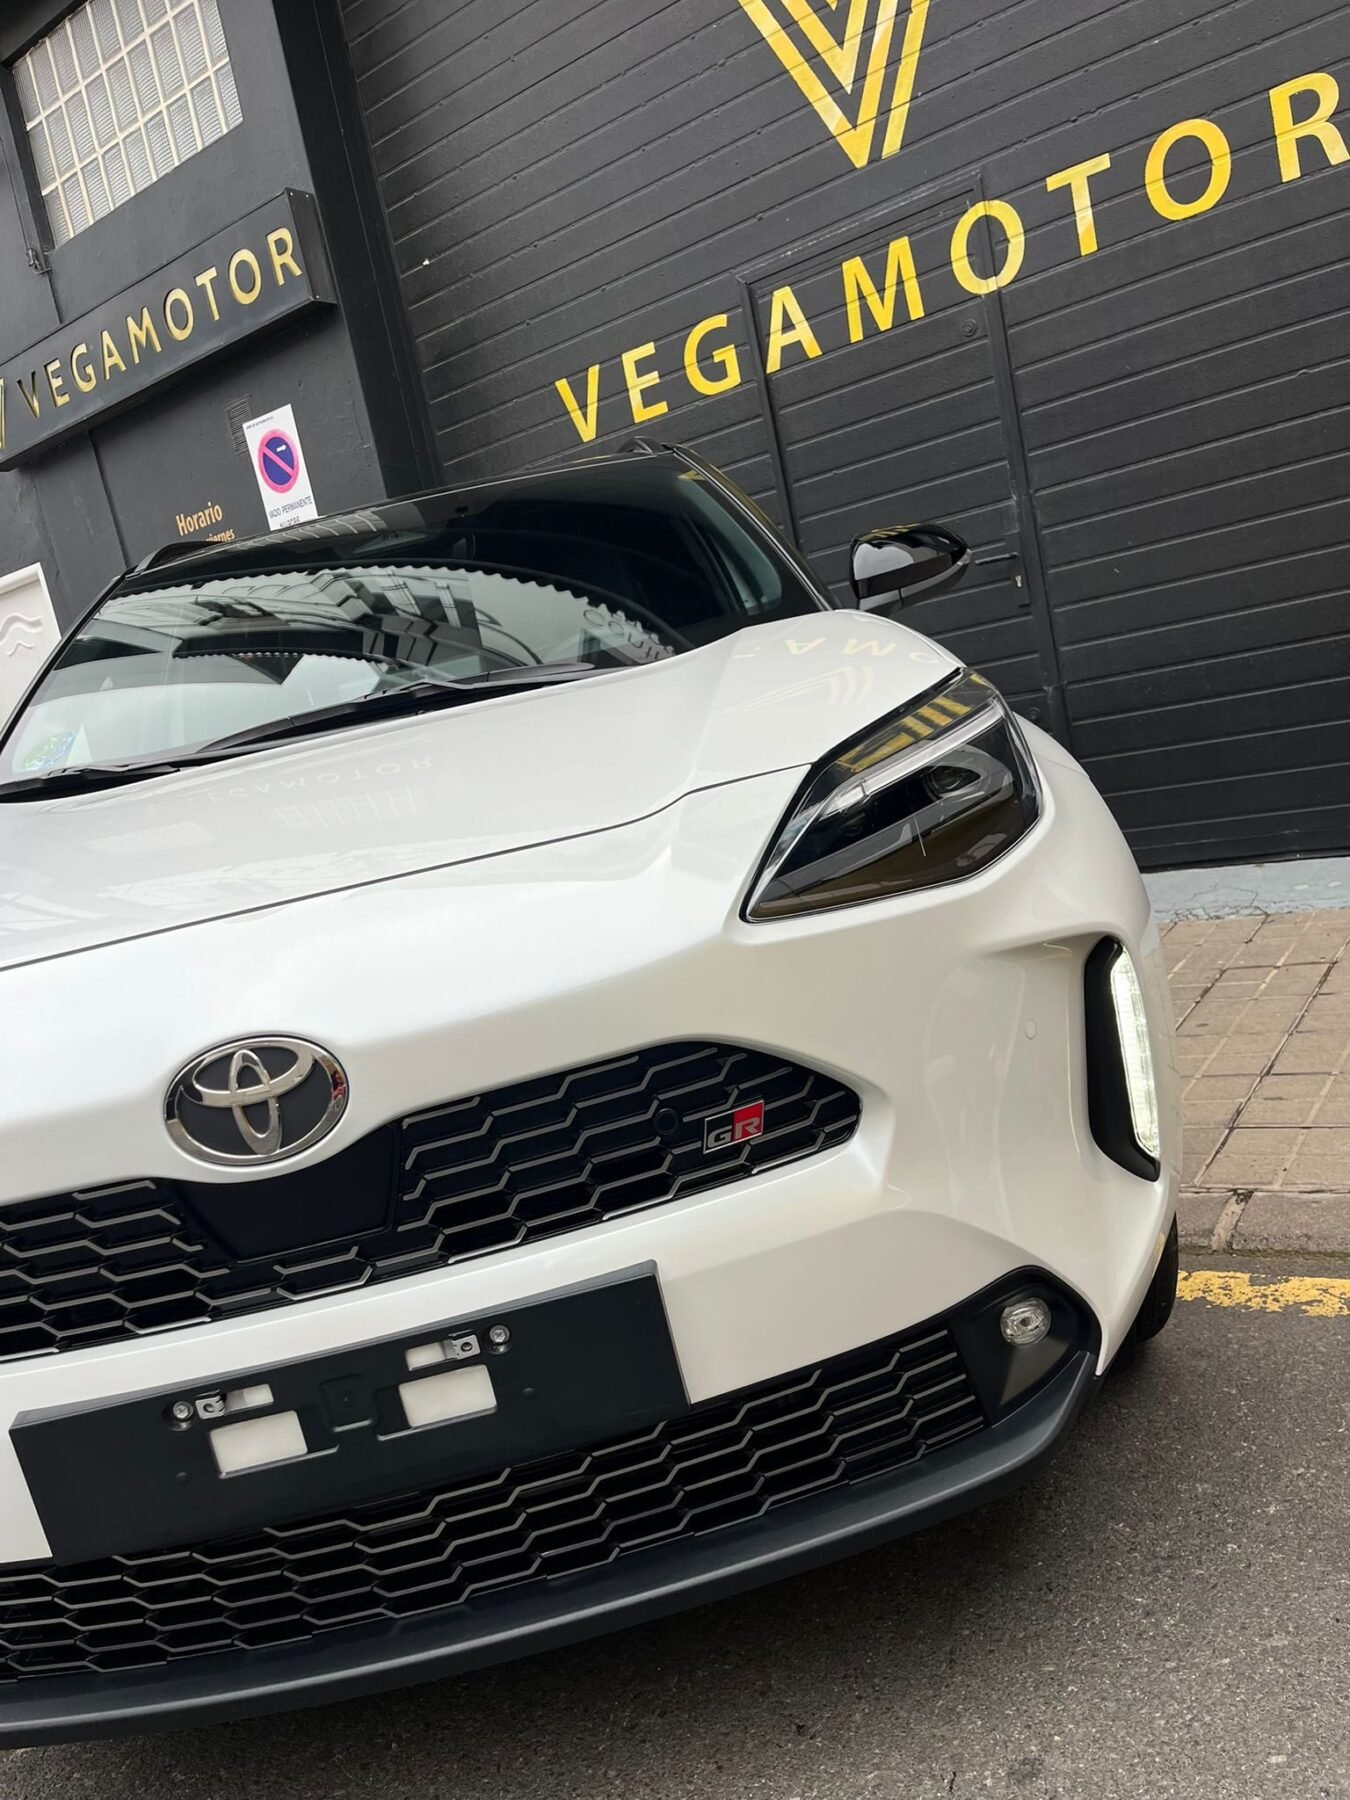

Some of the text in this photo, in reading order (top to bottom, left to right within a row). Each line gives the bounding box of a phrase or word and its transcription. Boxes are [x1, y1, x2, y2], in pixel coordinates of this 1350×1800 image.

[554, 73, 1350, 442] VEGAMOTOR
[17, 227, 303, 418] VEGAMOTOR
[176, 501, 223, 536] Horario
[205, 528, 236, 543] iernes
[707, 1117, 761, 1148] GR
